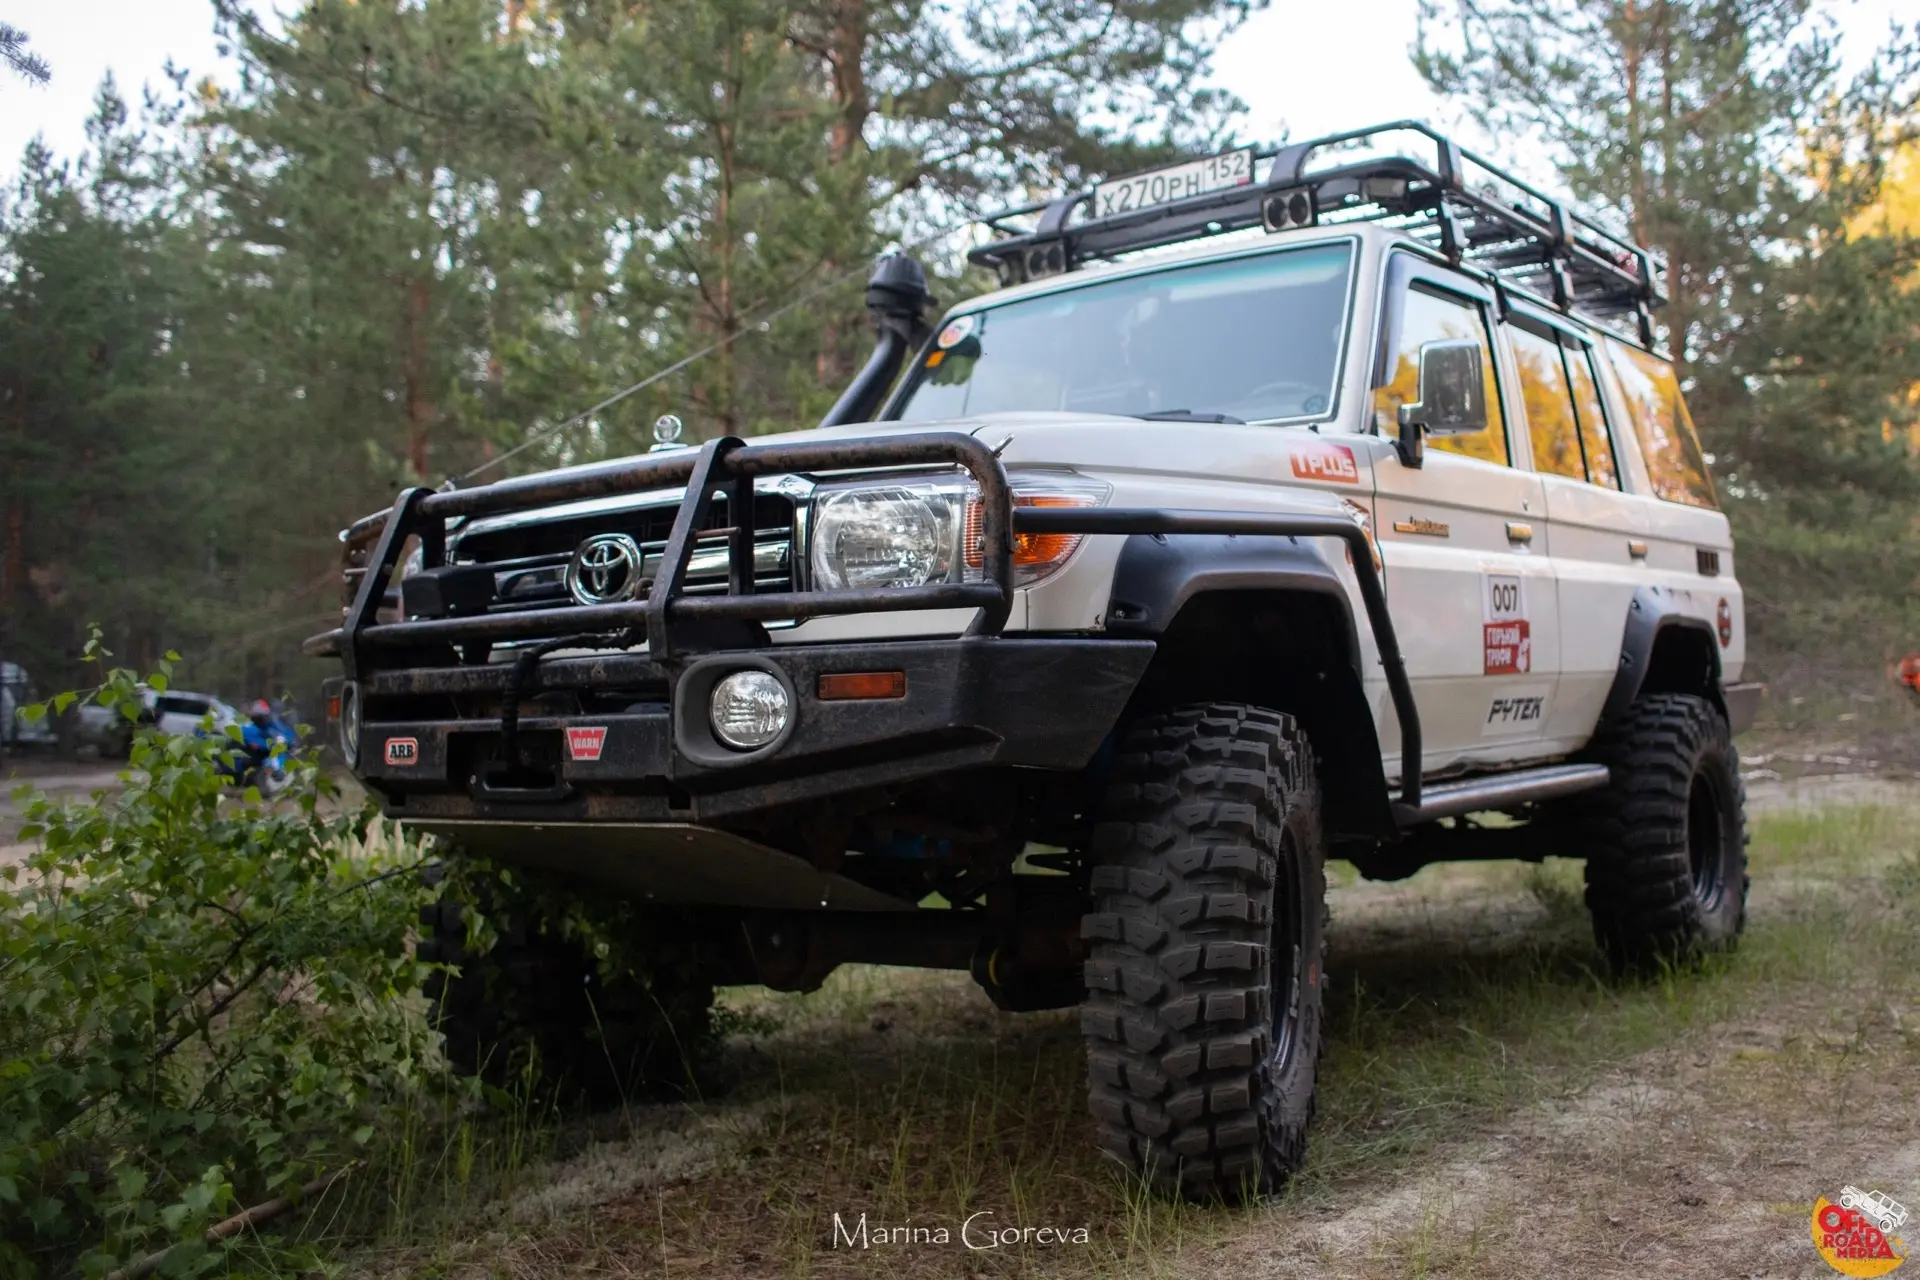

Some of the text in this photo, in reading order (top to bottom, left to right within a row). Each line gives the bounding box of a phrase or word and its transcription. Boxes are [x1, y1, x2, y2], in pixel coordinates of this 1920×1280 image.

[1208, 154, 1245, 181] 152
[1493, 584, 1518, 611] 007
[389, 744, 414, 758] ARB
[573, 737, 599, 749] WARN
